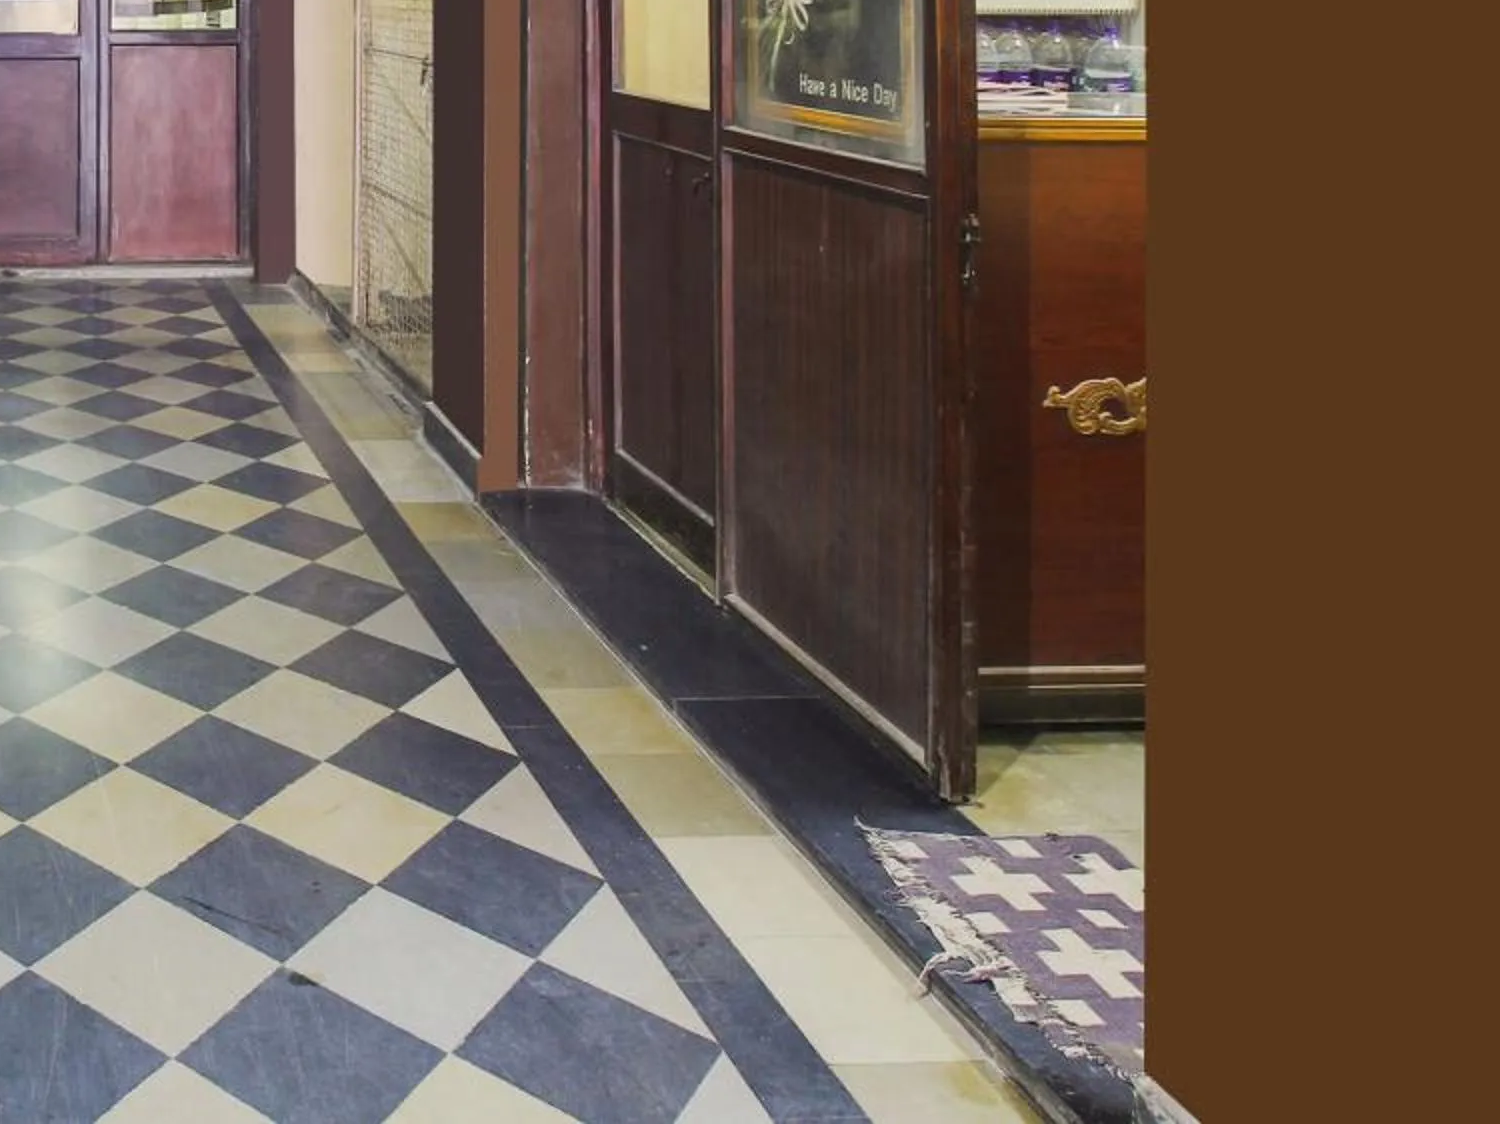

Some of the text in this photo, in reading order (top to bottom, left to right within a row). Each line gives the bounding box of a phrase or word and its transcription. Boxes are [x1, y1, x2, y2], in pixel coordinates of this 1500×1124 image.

[799, 74, 897, 112] Have a Nice Day
